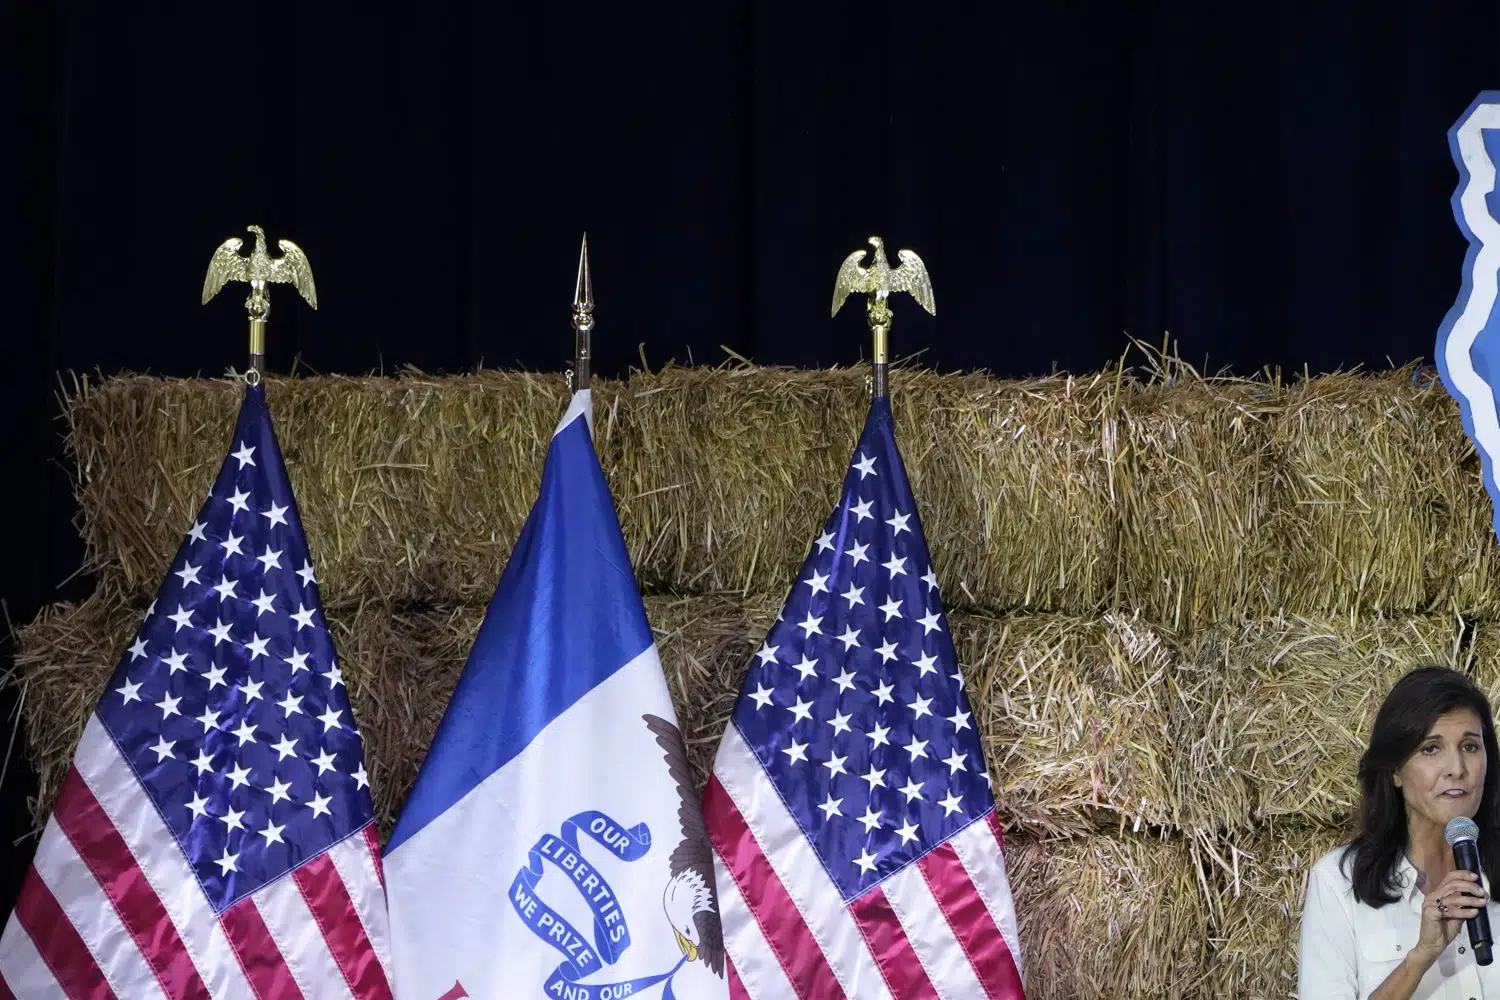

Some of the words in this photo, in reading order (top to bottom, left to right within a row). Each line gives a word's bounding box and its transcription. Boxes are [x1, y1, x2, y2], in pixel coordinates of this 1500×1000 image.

[590, 817, 631, 854] OUR
[542, 838, 626, 943] LIBERTIES
[514, 888, 538, 922] WE
[536, 911, 593, 968] PRIZE
[599, 982, 633, 1000] OUR
